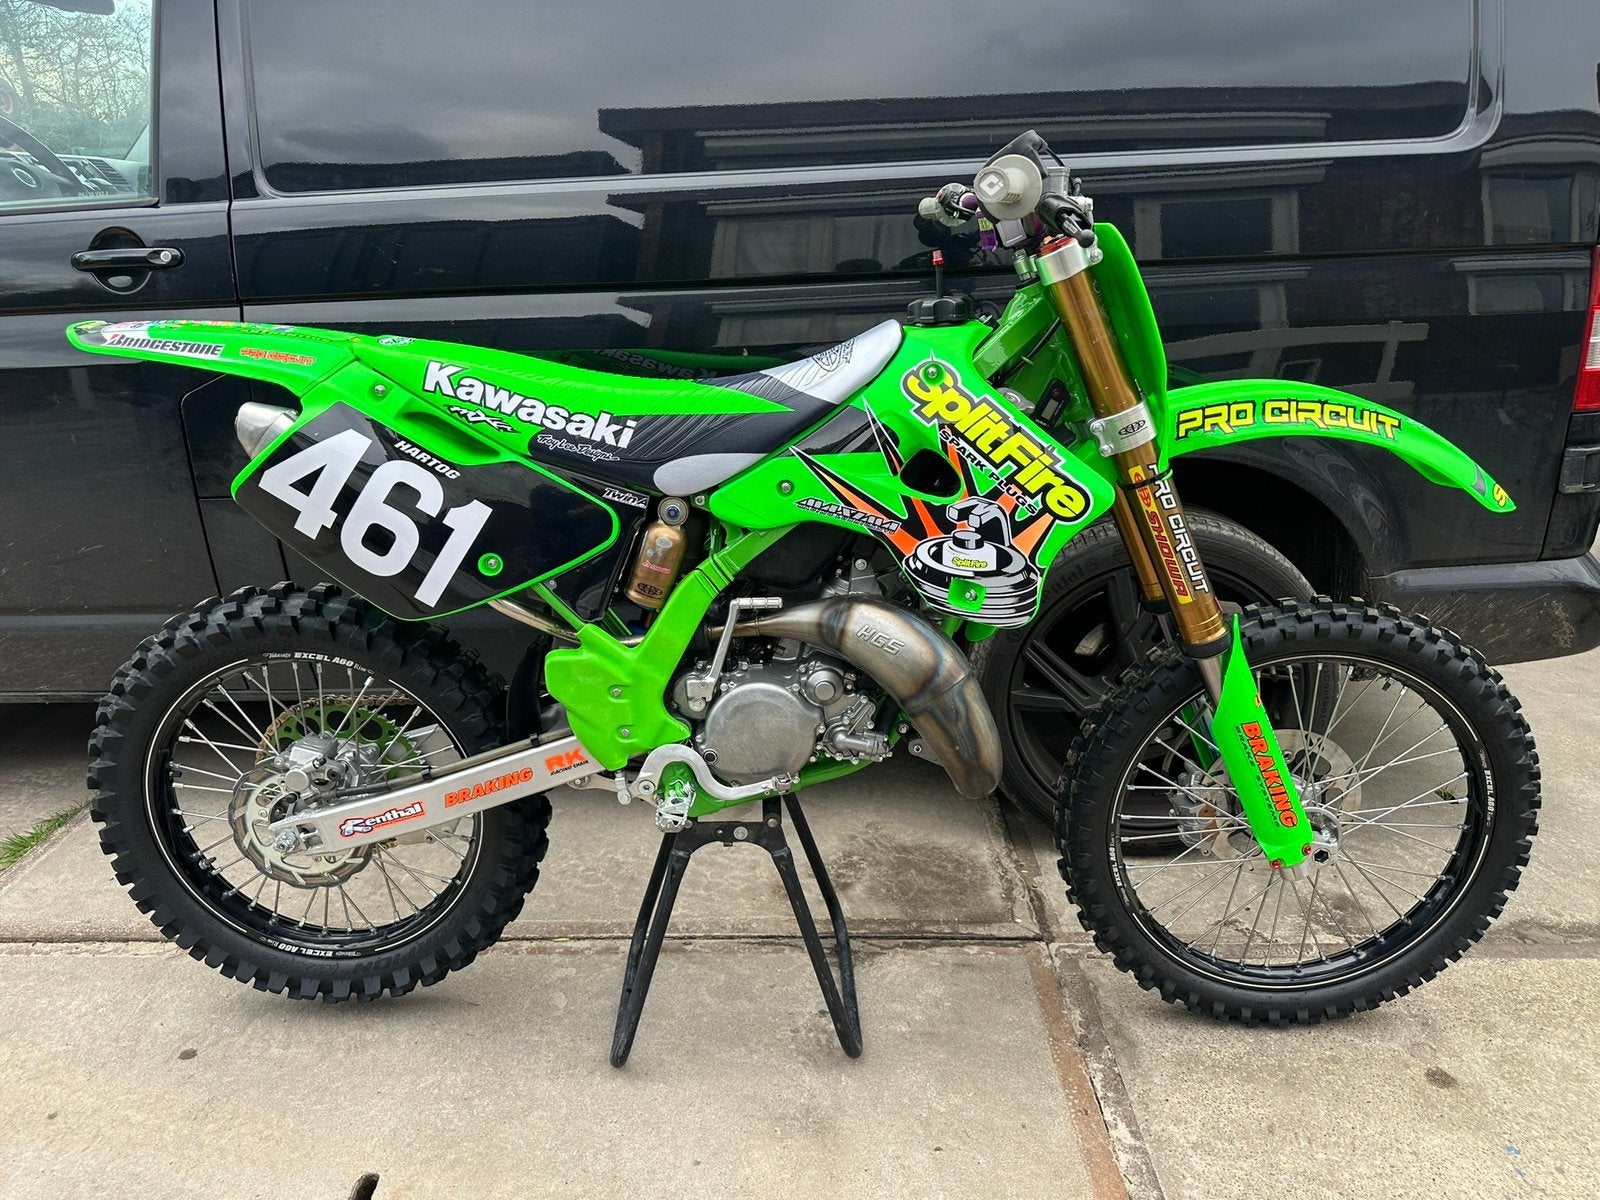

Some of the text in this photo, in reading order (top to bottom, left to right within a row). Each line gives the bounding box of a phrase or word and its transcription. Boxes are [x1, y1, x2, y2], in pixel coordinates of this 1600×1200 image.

[107, 333, 223, 356] BRIDGESTONE
[240, 347, 316, 366] PRO CIRCUIT
[422, 360, 638, 449] Kawasaki
[1176, 400, 1257, 441] PRO
[1262, 398, 1401, 441] CIRCUIT
[536, 433, 621, 462] Troy Lee Designs
[905, 364, 1087, 518] SplitFire
[394, 440, 462, 480] HARTOG
[938, 428, 1038, 516] SPARK PLUGS
[258, 428, 494, 608] 461
[951, 556, 988, 569] SplitFire
[1145, 509, 1190, 597] SHOWA
[1168, 513, 1210, 594] CIRCUIT
[856, 624, 906, 656] HGS
[293, 651, 331, 662] EXCEL
[331, 659, 355, 667] A60
[544, 747, 587, 773] RK
[1240, 720, 1299, 829] BRAKING
[444, 766, 534, 808] BRAKING
[1484, 769, 1494, 795] EXCEL
[340, 802, 425, 837] Renthal
[1111, 861, 1123, 887] EXCEL
[300, 947, 333, 957] EXCEL
